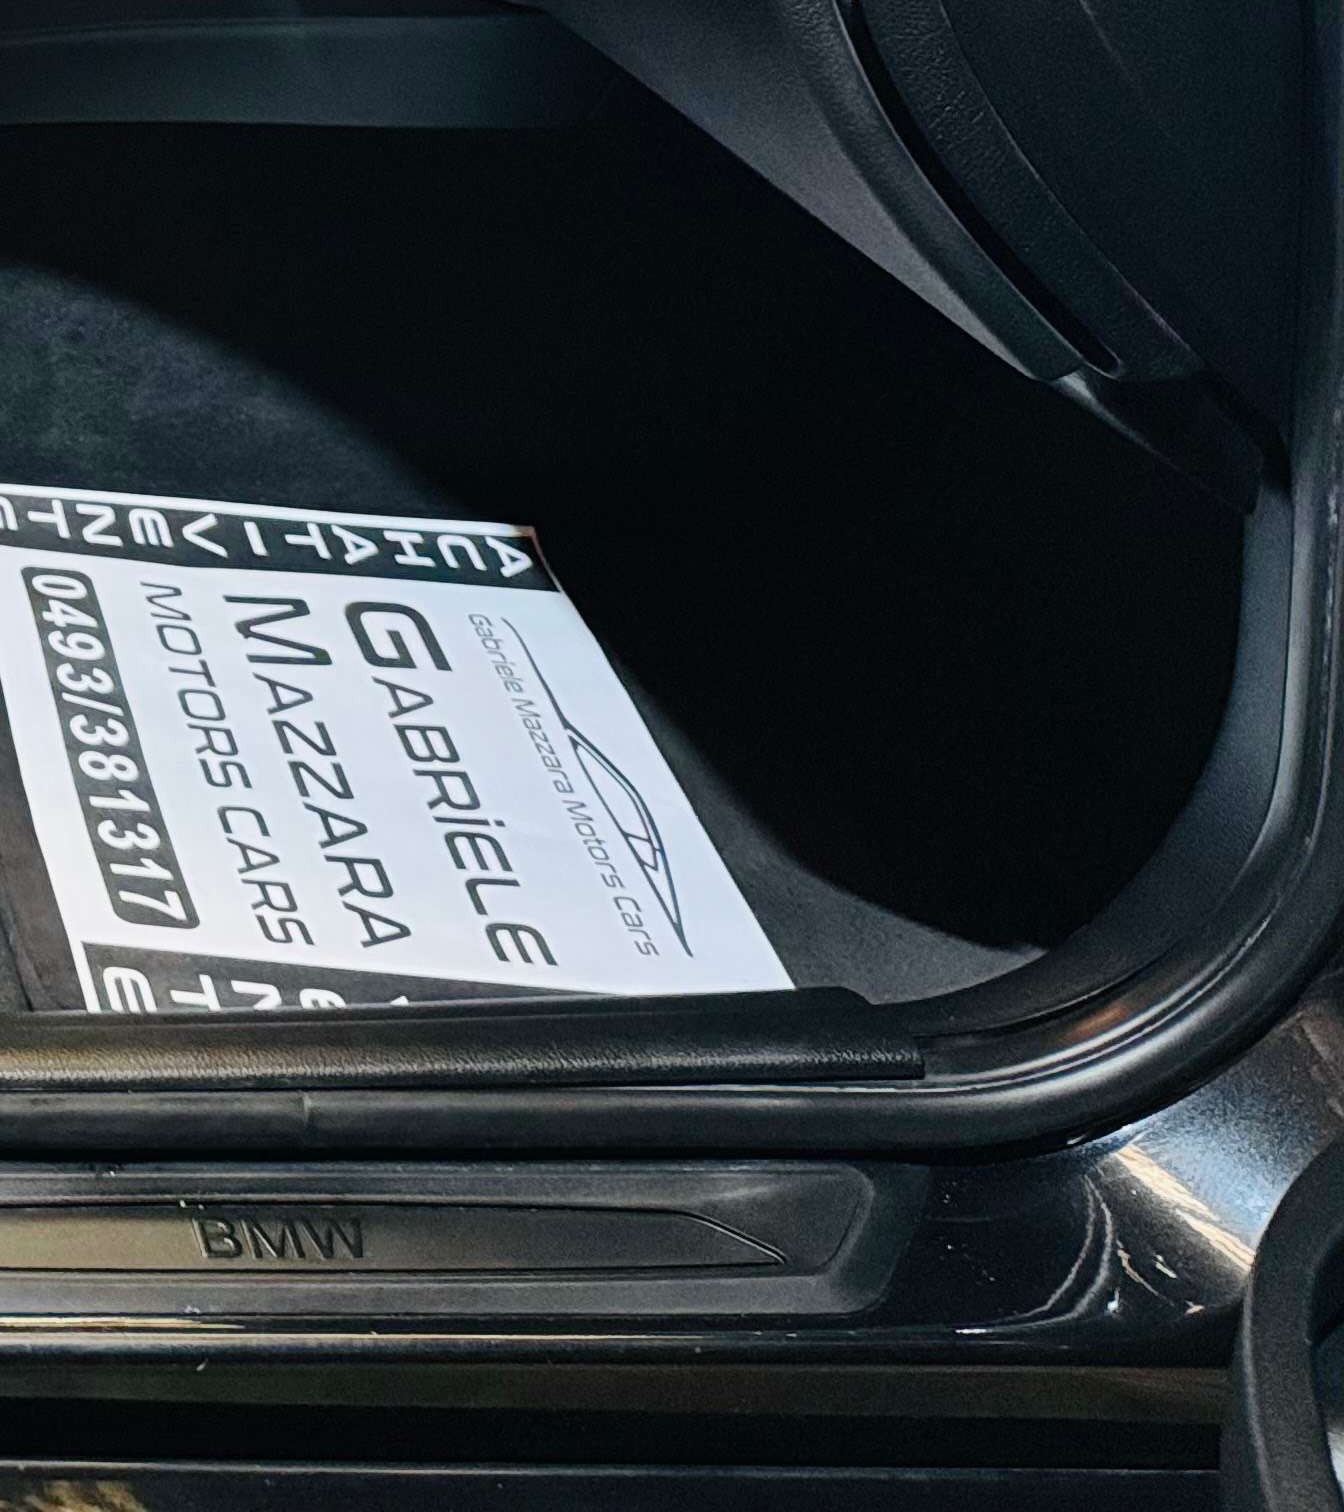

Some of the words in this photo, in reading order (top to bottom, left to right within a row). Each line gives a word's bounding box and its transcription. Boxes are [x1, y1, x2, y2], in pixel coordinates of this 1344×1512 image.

[30, 573, 191, 923] 0493/381317
[140, 580, 254, 789] MOTORS
[216, 805, 316, 946] CARS
[468, 613, 524, 702] Gabriele
[512, 697, 575, 794] Mazzara
[562, 798, 624, 890] Motors
[614, 895, 660, 958] Cars
[191, 1216, 365, 1260] BMW
